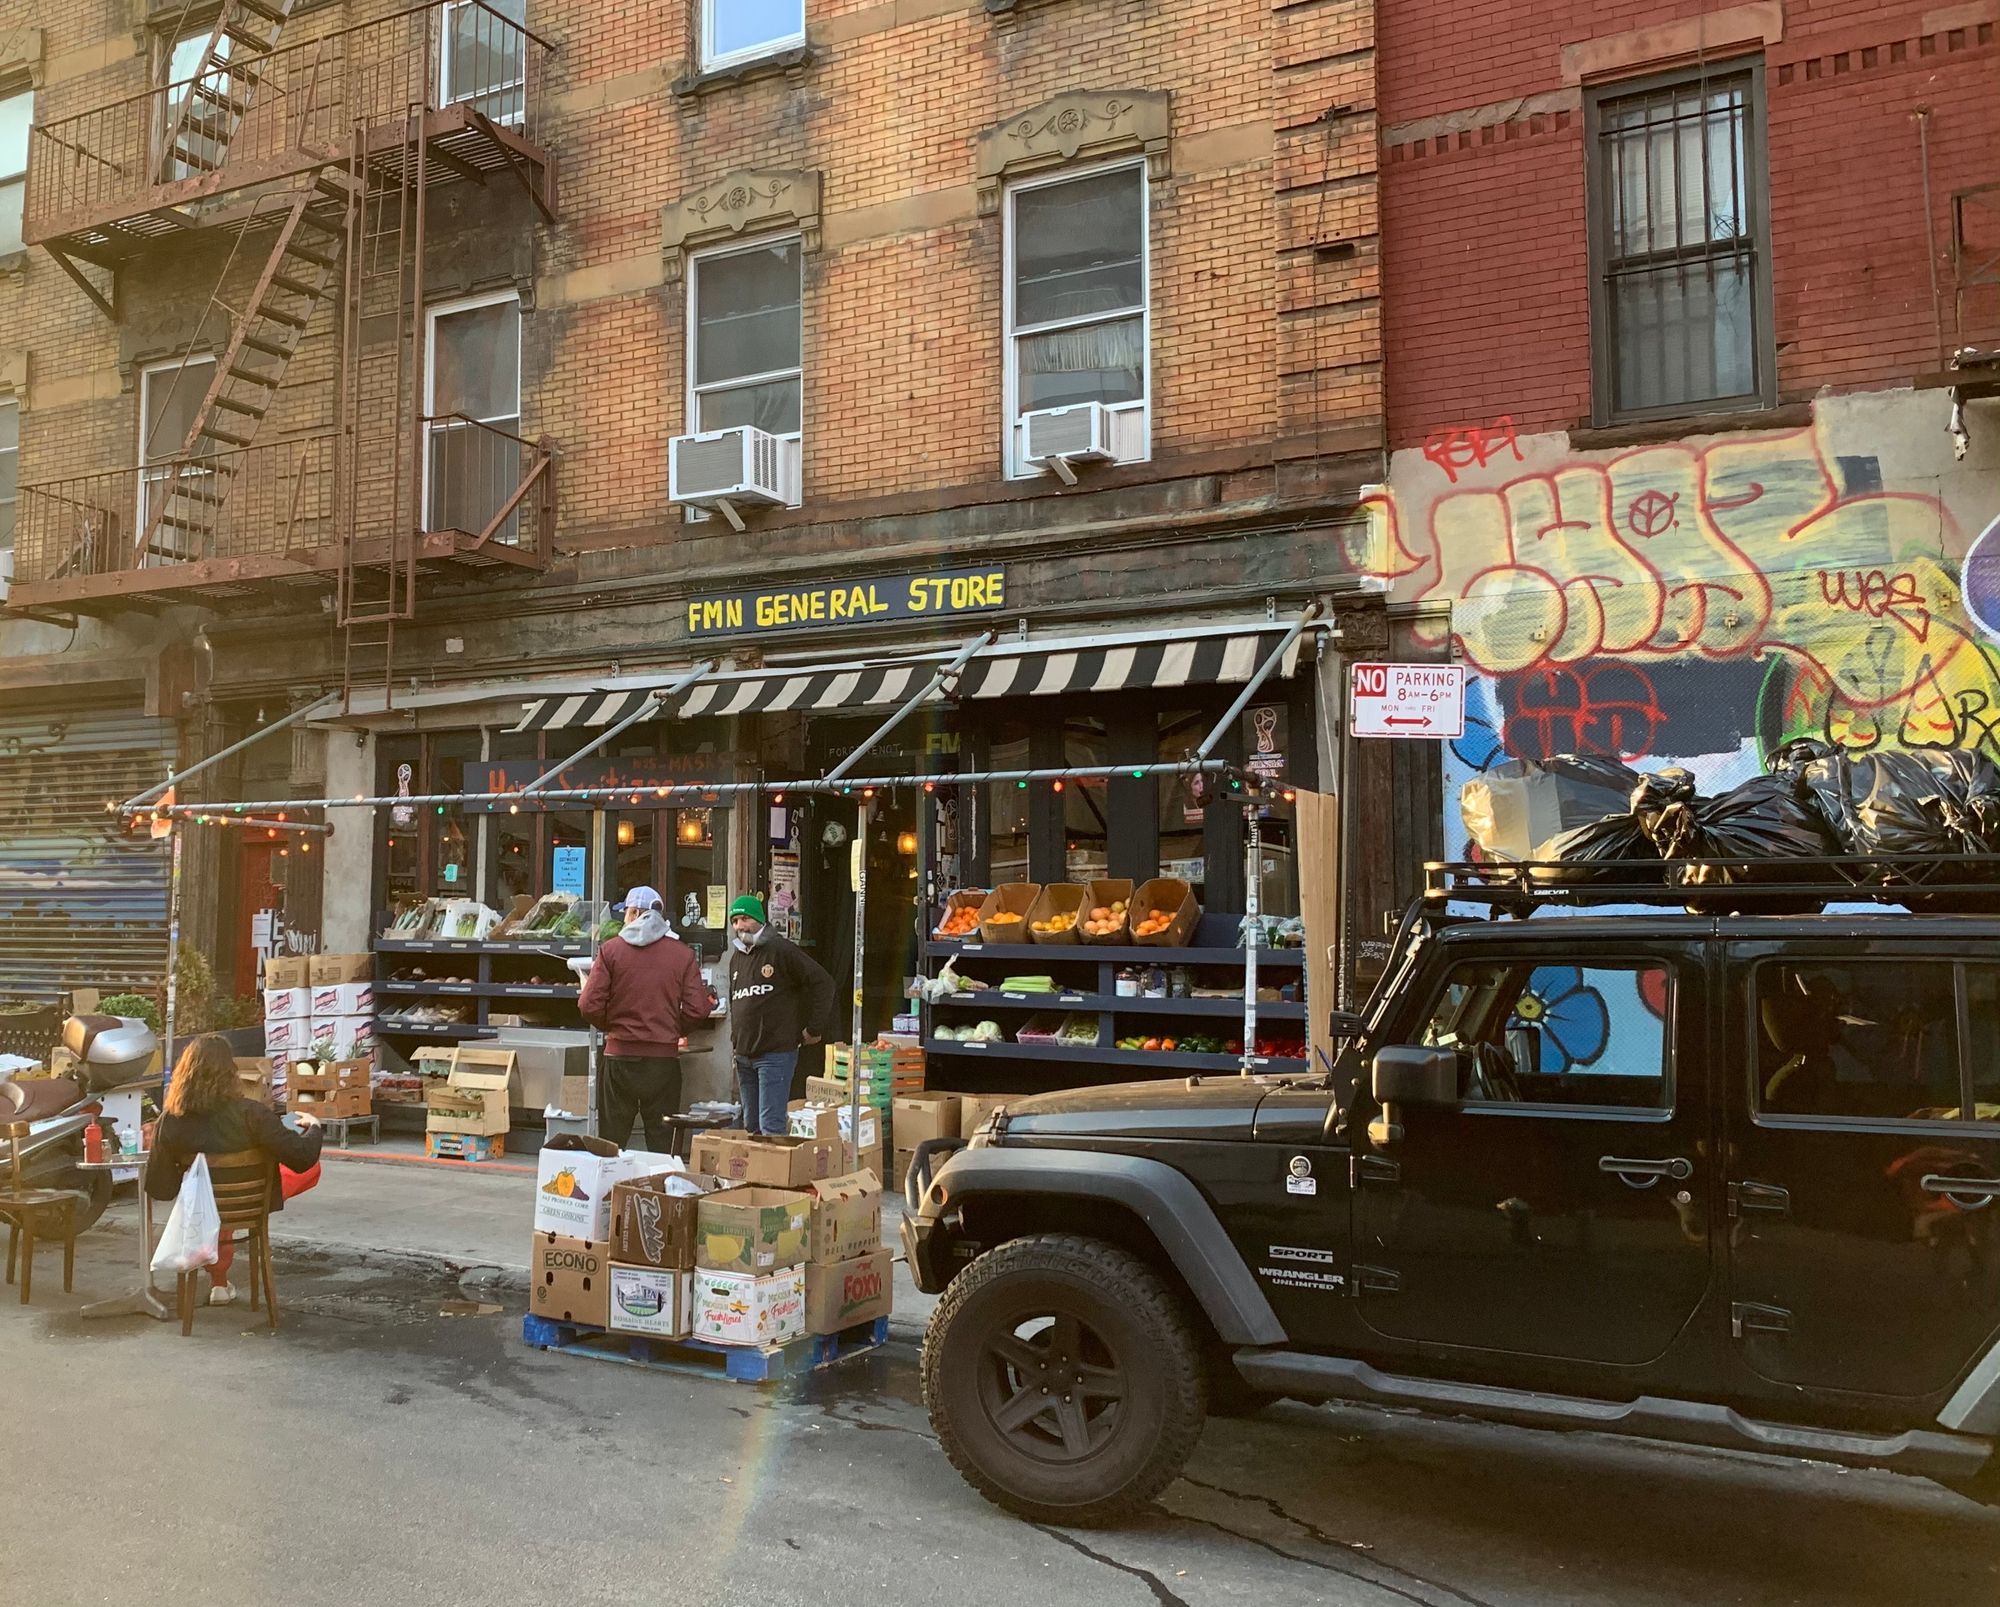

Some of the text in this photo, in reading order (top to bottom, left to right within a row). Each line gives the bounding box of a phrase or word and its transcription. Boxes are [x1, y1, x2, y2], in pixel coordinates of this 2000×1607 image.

[689, 573, 1004, 632] FMN GENERAL STORE
[1357, 669, 1455, 693] NO PARKING
[1421, 705, 1435, 713] FRI
[545, 1252, 597, 1272] ECONO
[1272, 1249, 1333, 1260] SPORT
[1258, 1267, 1345, 1285] WRANGLER
[1272, 1278, 1335, 1290] UNLIMITED
[844, 1271, 881, 1302] FOXY
